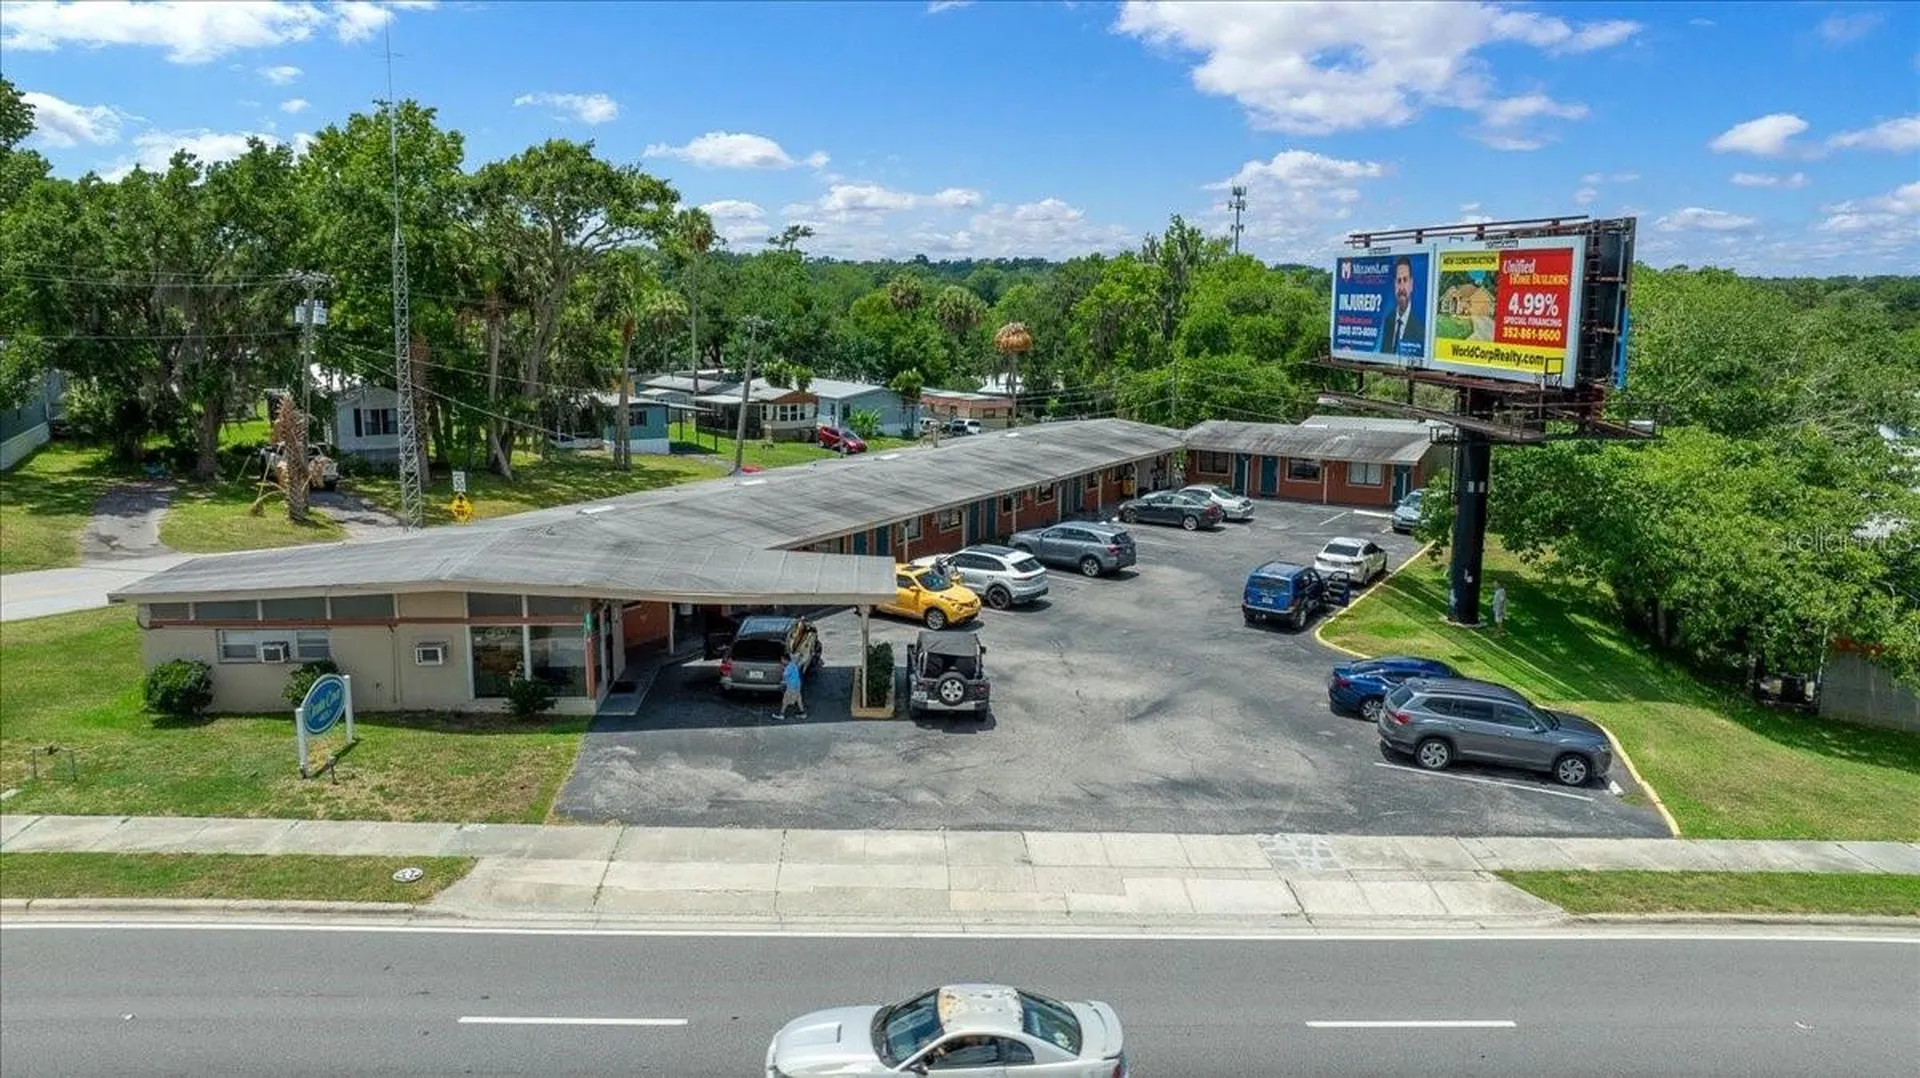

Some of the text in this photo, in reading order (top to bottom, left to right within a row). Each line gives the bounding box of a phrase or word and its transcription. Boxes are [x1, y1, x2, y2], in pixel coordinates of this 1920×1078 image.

[1502, 258, 1536, 274] Unified
[1509, 273, 1568, 286] HOME BUILDERS
[1338, 293, 1383, 312] INJURED?
[1508, 292, 1559, 317] 4.99%
[1503, 316, 1562, 328] SPECIAL FINANCING
[1451, 344, 1545, 367] WorldCorpRealty.com
